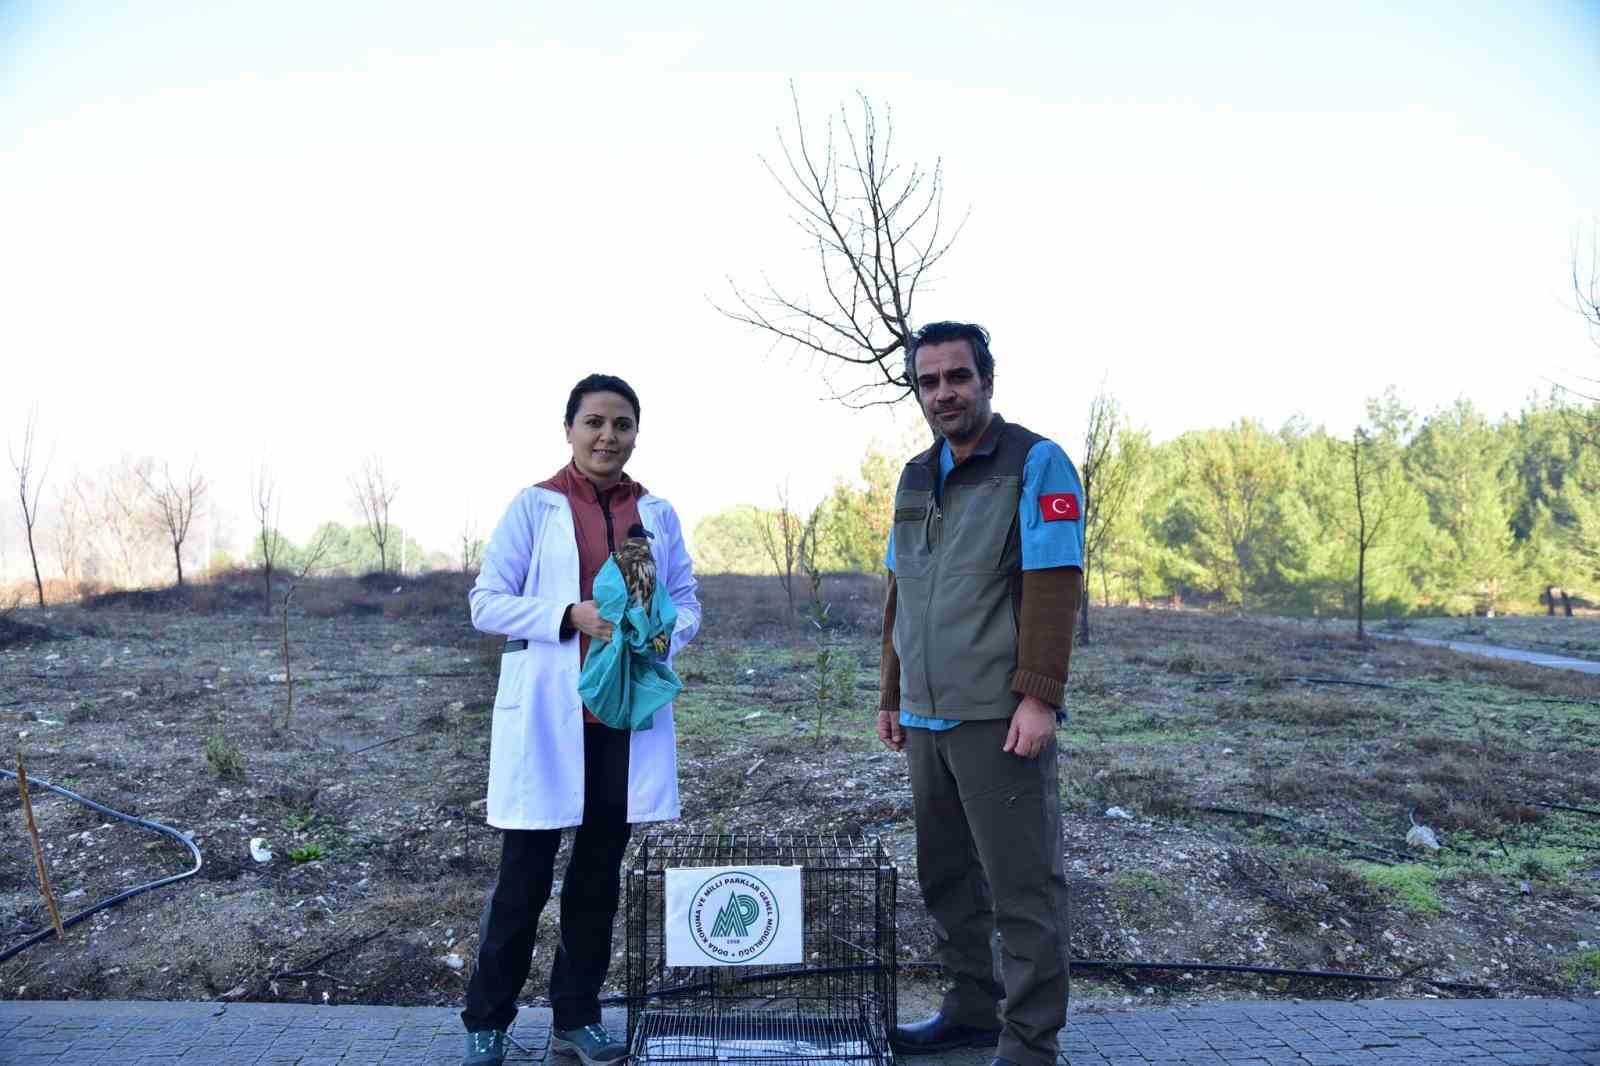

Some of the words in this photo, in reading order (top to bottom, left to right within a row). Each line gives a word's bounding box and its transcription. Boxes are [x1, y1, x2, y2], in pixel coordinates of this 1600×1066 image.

[704, 880, 723, 897] MİLLİ
[724, 878, 759, 892] PARKLAR
[698, 897, 706, 907] VE
[759, 891, 773, 916] GENEL
[696, 909, 708, 944] KORUMA
